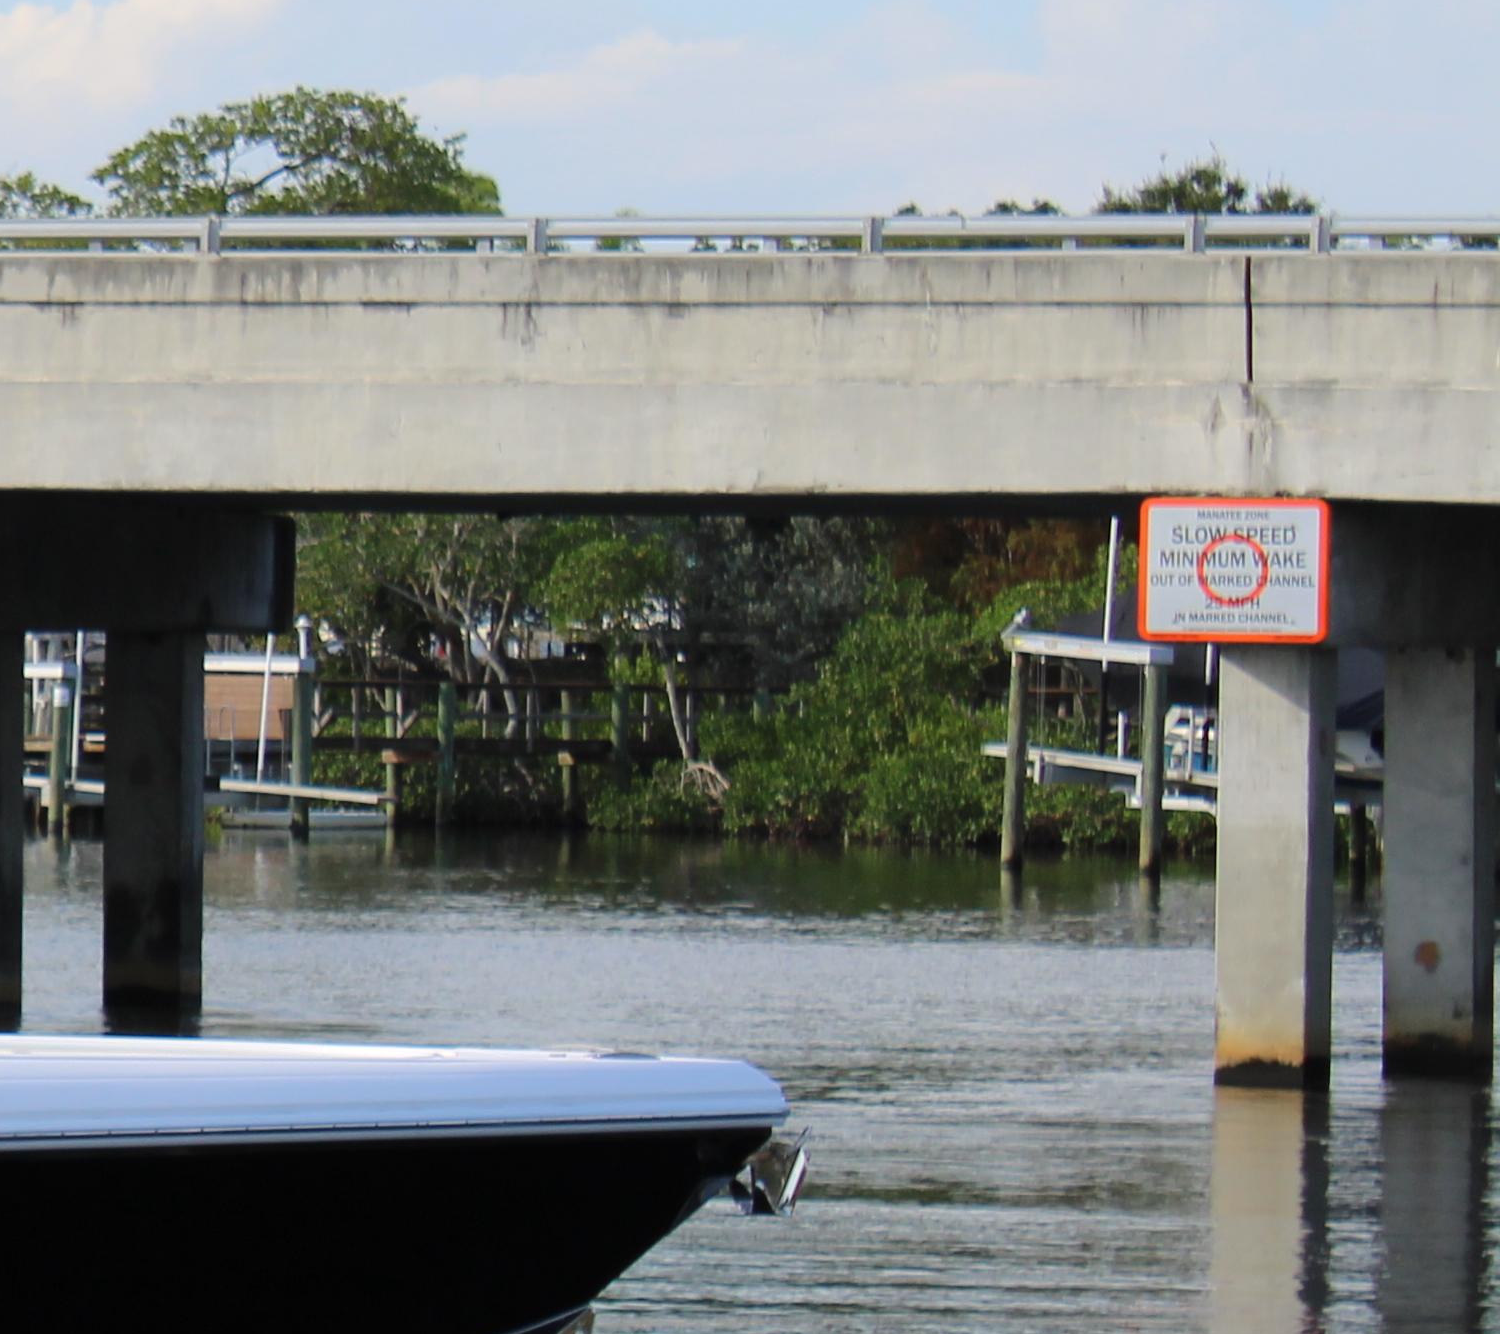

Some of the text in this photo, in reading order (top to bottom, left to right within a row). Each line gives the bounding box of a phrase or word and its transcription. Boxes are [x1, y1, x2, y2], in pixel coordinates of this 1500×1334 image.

[1197, 510, 1270, 520] MANATEE ZONE
[1171, 525, 1297, 545] SLOW SPEED
[1159, 550, 1307, 569] MINIMUM WAKE
[1150, 575, 1316, 588] OUT OF MARKED CHANNEL
[1228, 597, 1260, 609] MPH
[1188, 612, 1236, 624] MARKED
[1238, 613, 1288, 625] CHANNEL
